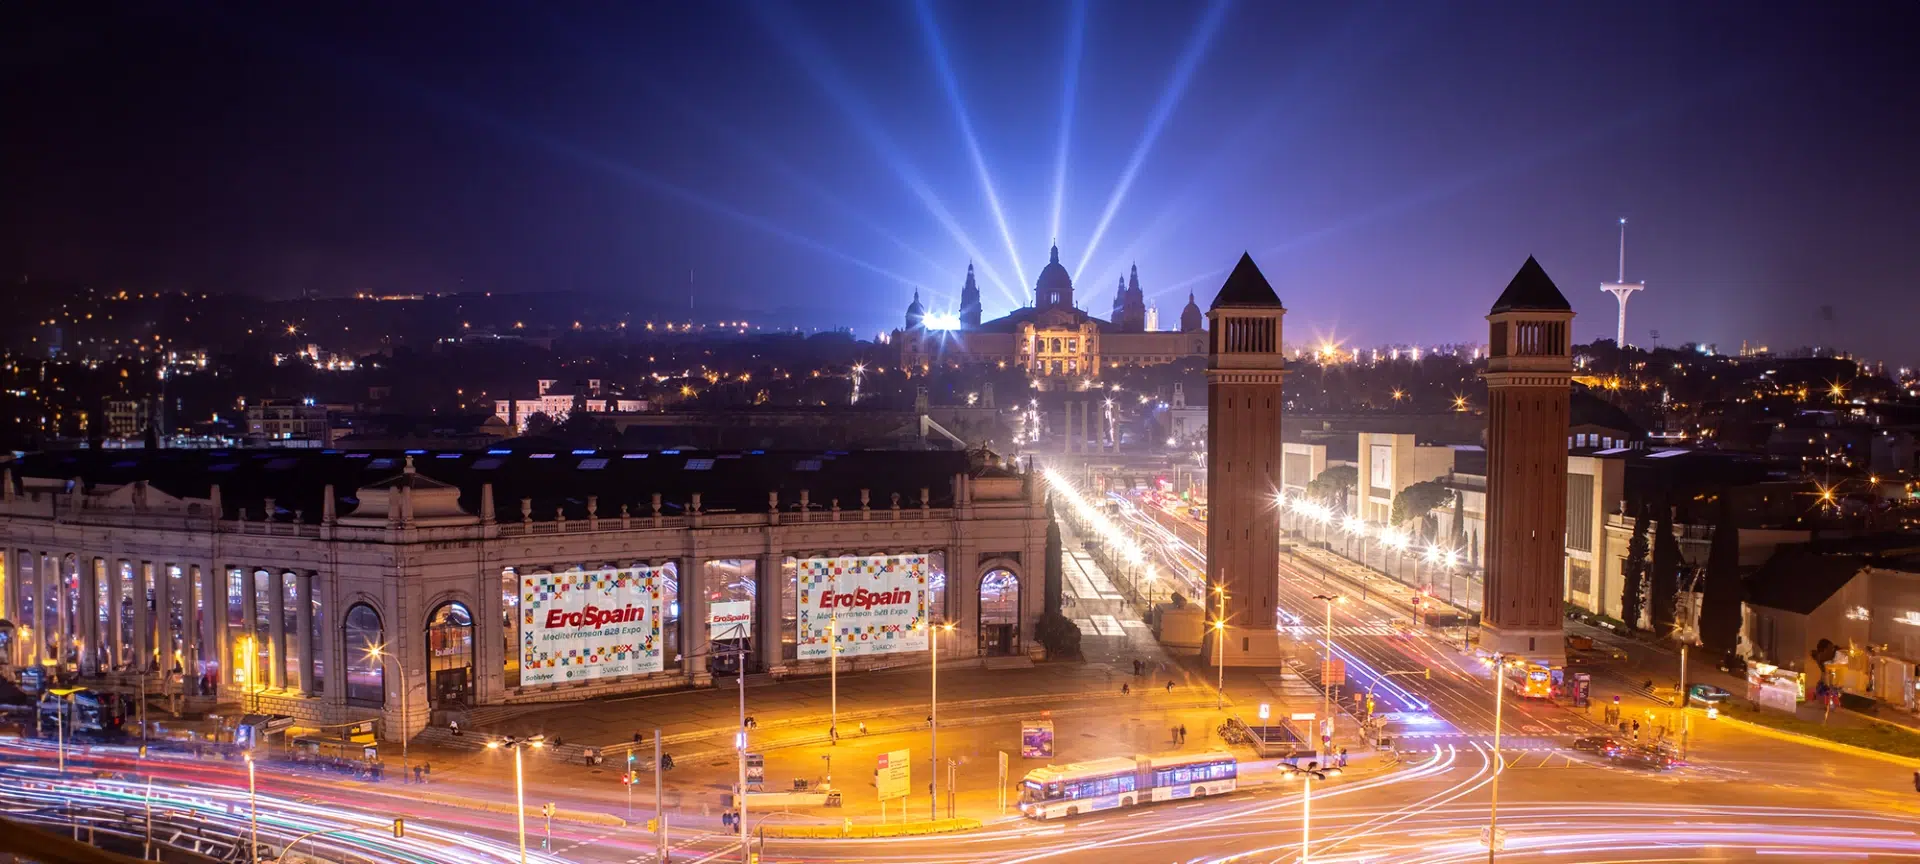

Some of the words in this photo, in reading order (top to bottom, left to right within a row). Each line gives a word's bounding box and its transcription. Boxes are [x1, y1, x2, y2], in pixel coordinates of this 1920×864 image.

[713, 613, 750, 623] EroSpain
[816, 610, 872, 620] Medterranean
[874, 608, 888, 617] B2B
[890, 607, 908, 617] Expo
[542, 630, 602, 641] Mediterranean
[604, 627, 620, 636] B2B
[621, 626, 642, 636] Expo
